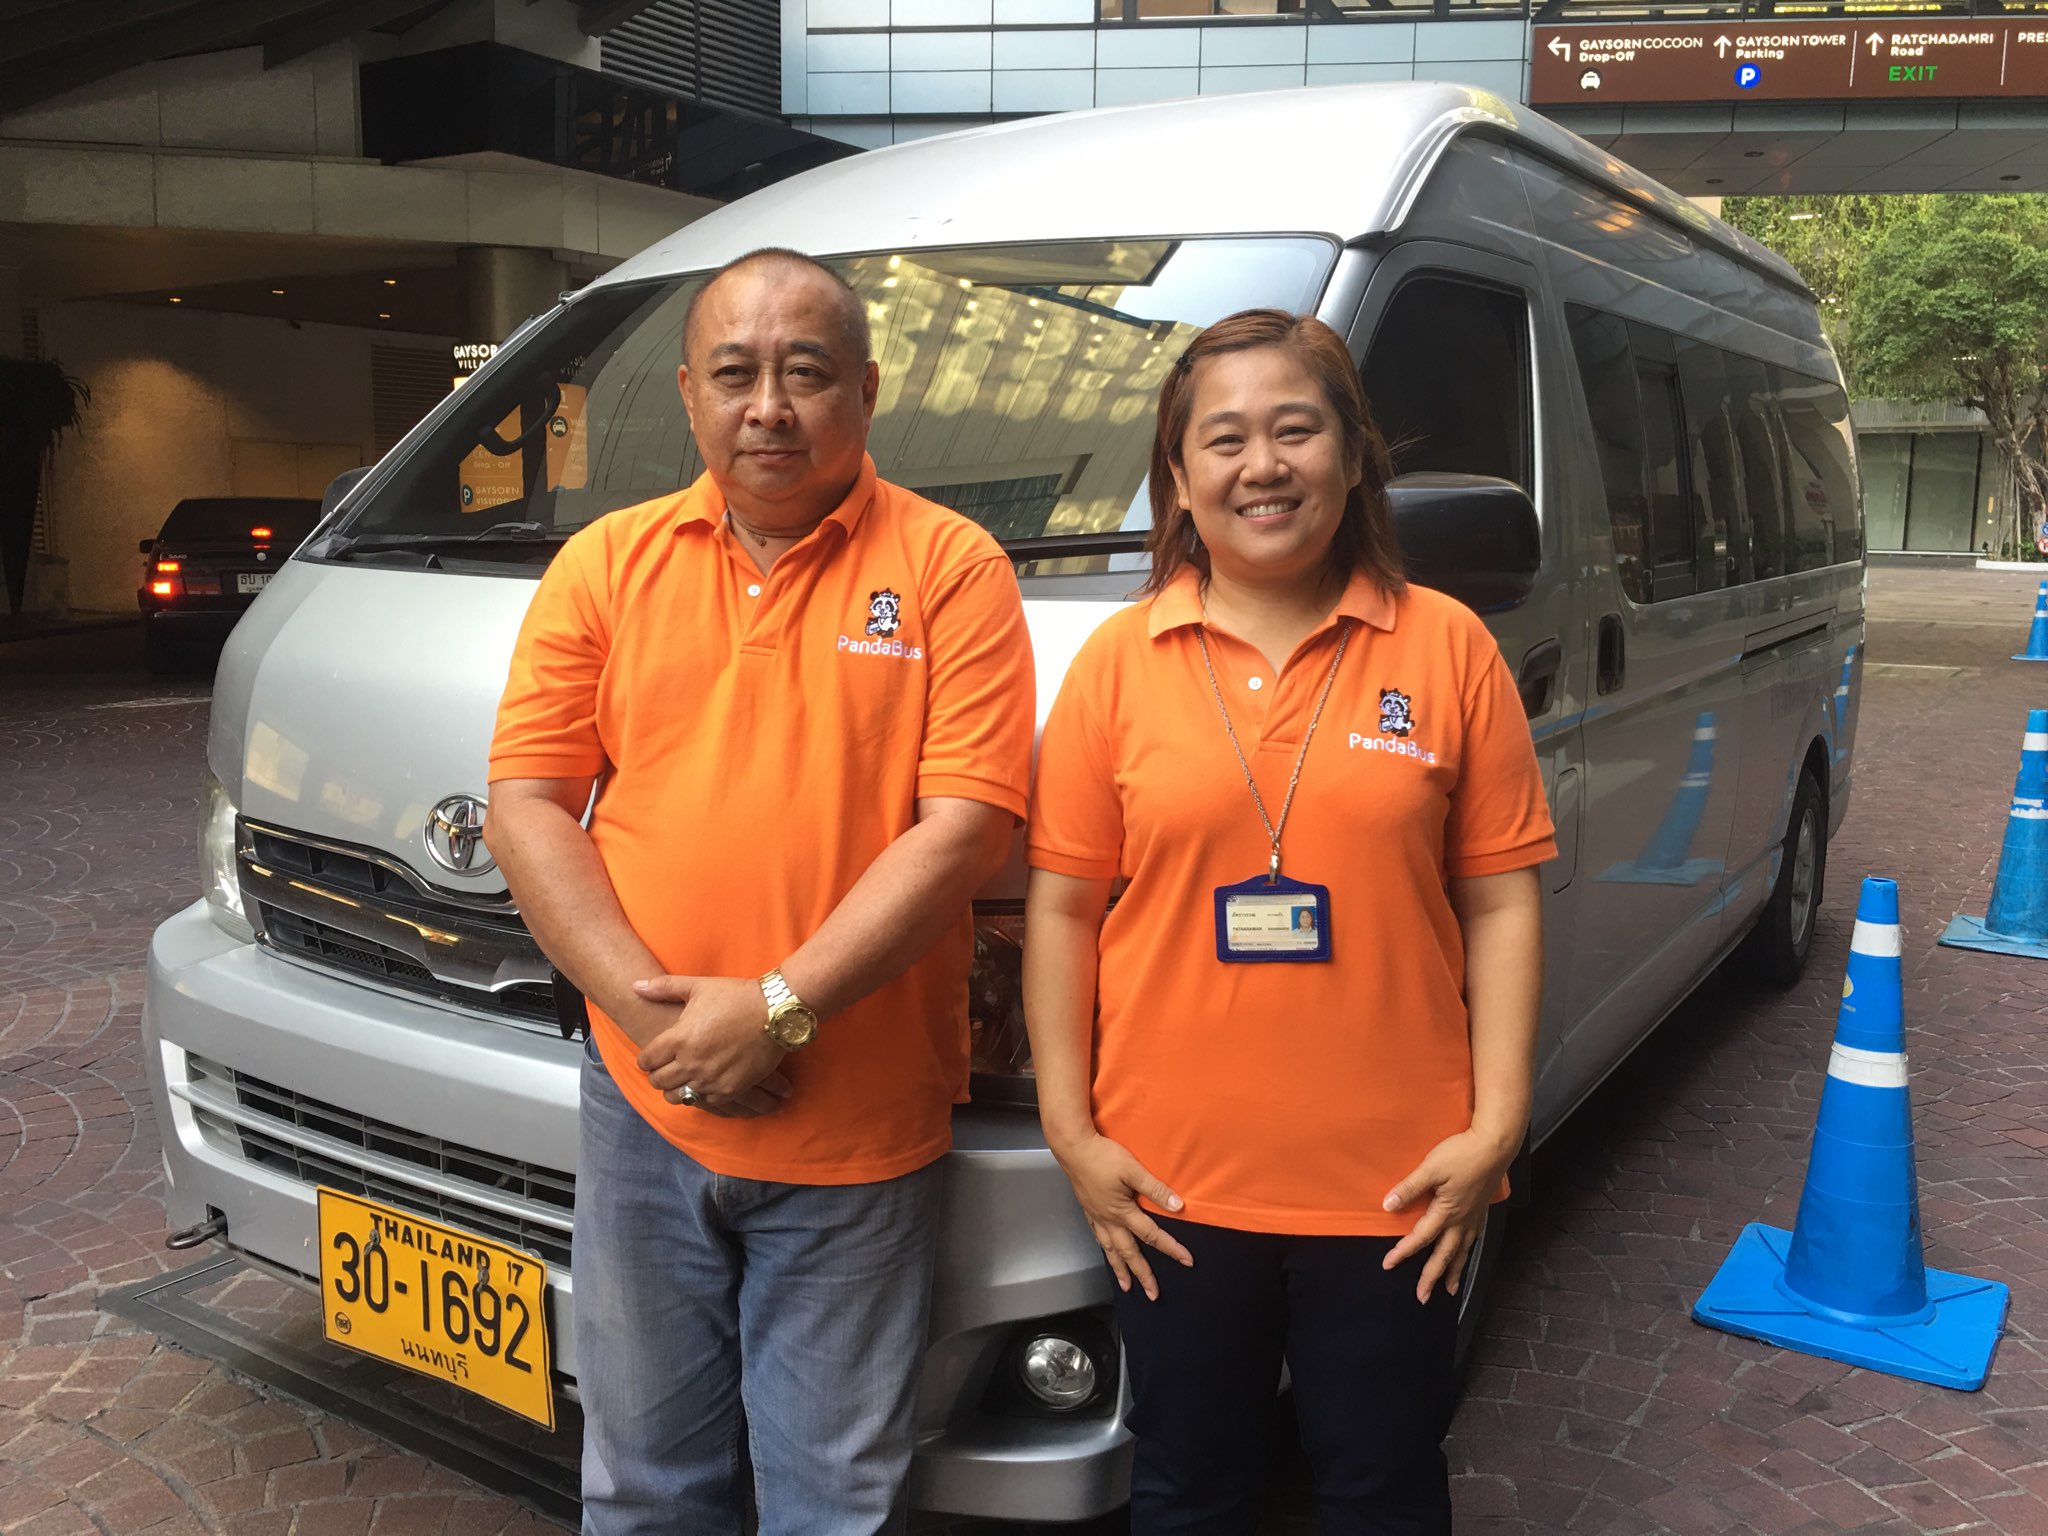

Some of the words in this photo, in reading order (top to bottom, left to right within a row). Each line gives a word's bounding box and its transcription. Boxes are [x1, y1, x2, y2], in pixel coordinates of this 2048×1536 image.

[1579, 38, 1642, 50] GAYSORN
[1643, 37, 1703, 49] COCOON
[1735, 36, 1800, 47] GAYSORN
[1801, 34, 1847, 46] TOWER
[1891, 33, 1994, 45] RATCHADAMRI
[1579, 51, 1635, 63] Drop-Off
[1735, 48, 1785, 60] Parking
[1890, 46, 1924, 56] Road
[1888, 65, 1938, 81] EXIT
[475, 486, 519, 495] GAYSORN
[837, 635, 922, 659] PandaBus
[1349, 732, 1436, 764] PandaBus
[369, 1212, 491, 1271] THAILAND
[507, 1261, 524, 1287] 17
[333, 1231, 532, 1374] 30-1692
[400, 1337, 469, 1381] นนทบุรี
